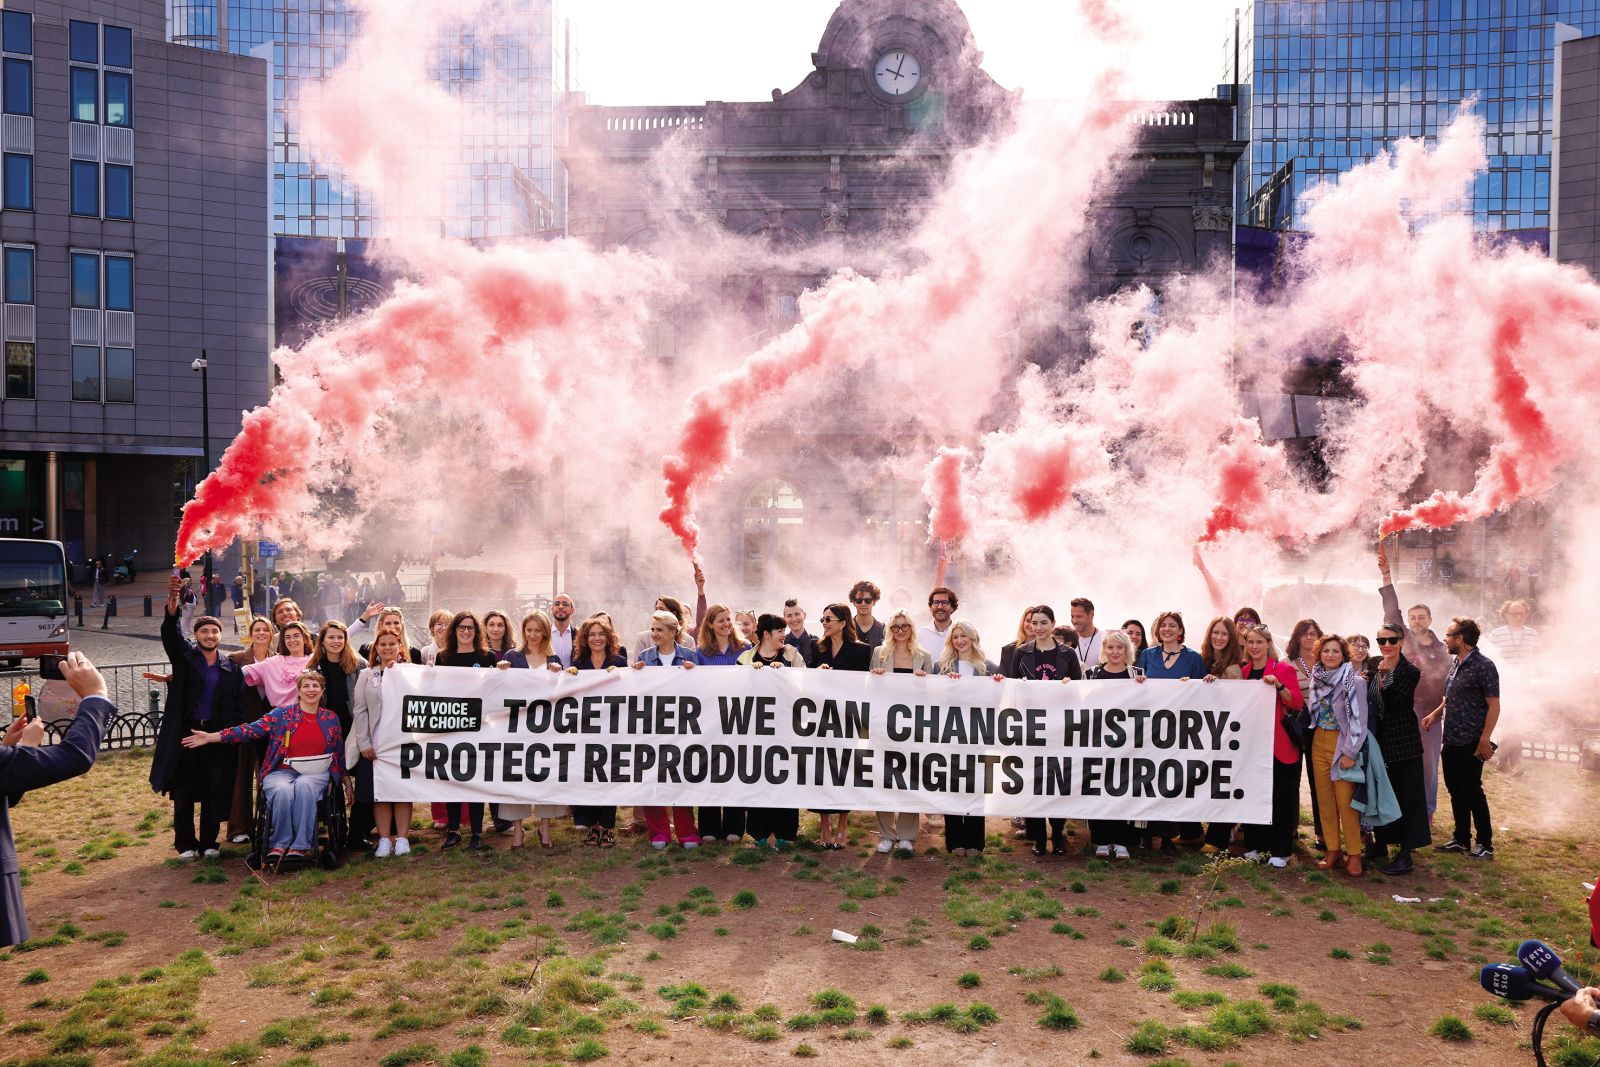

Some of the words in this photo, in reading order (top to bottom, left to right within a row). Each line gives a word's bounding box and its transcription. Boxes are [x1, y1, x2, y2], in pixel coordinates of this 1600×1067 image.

[407, 700, 428, 714] MY
[430, 701, 468, 715] VOICE
[406, 715, 427, 728] MY
[429, 715, 477, 730] CHOICE
[503, 694, 702, 735] TOGETHER
[718, 696, 776, 736] WE
[793, 697, 871, 740] CAN
[887, 703, 1047, 747] CHANGE
[1064, 709, 1240, 751] HISTORY:
[400, 742, 575, 783] PROTECT
[584, 743, 875, 788] REPRODUCTIVE
[884, 750, 1024, 795] RIGHTS
[1033, 756, 1072, 797] IN
[1081, 757, 1245, 800] EUROPE.
[1529, 947, 1544, 961] RTV
[1535, 953, 1552, 967] SLO
[1493, 972, 1501, 987] RTV
[1501, 974, 1509, 990] SLO
